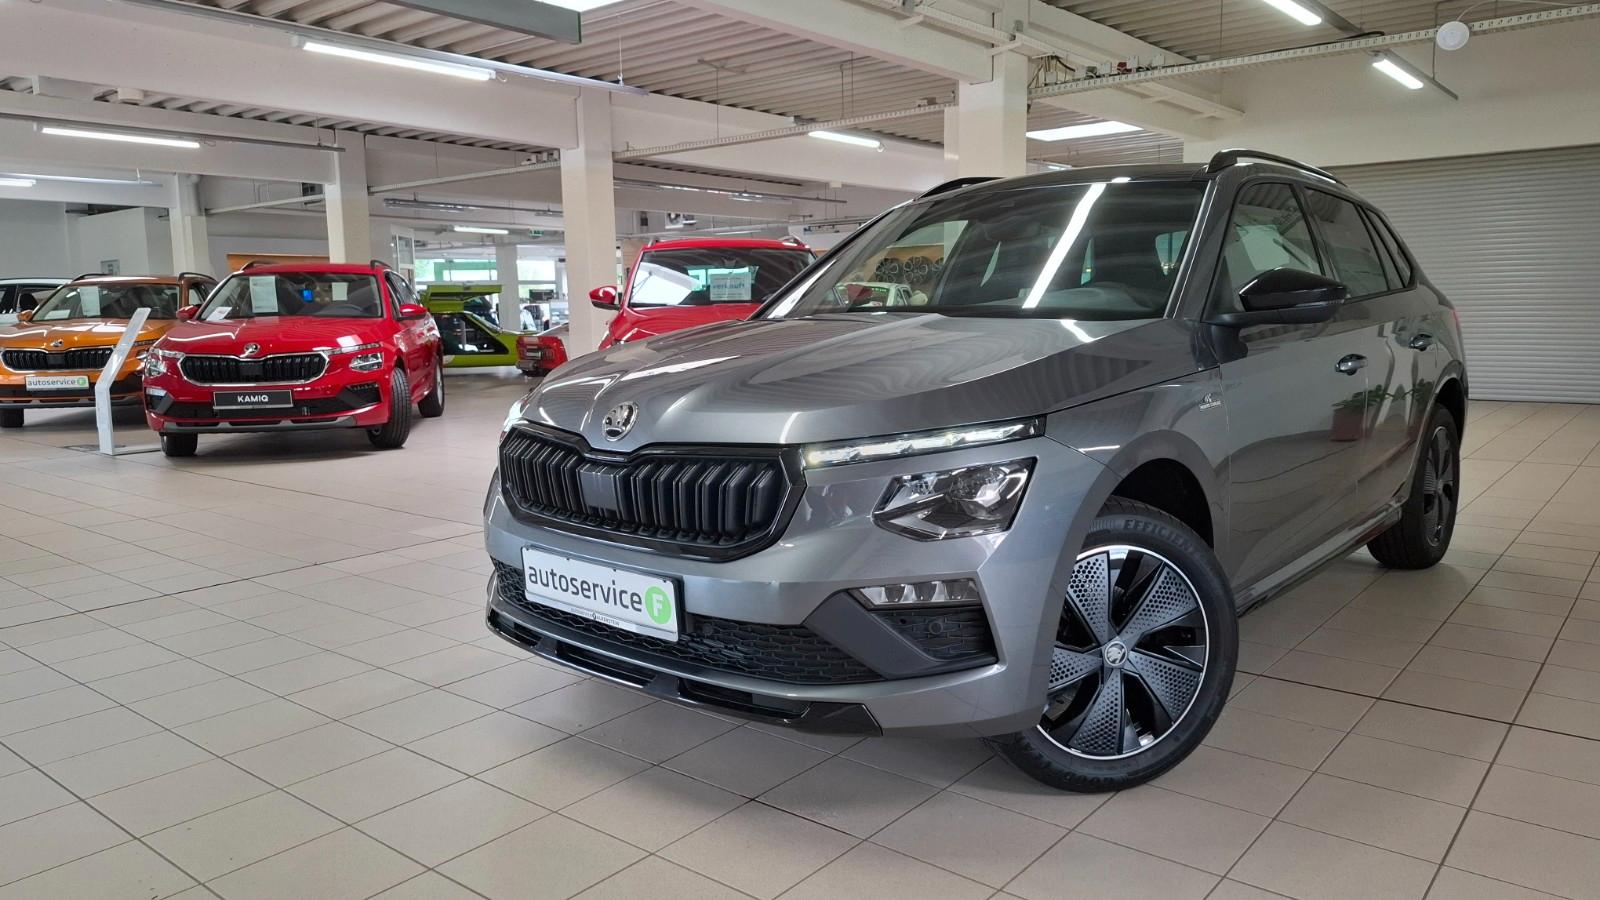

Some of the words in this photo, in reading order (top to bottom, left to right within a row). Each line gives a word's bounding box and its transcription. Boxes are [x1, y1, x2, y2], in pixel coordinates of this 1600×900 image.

[27, 377, 76, 387] autoservice
[237, 394, 269, 403] KAMIQ
[528, 565, 643, 612] autoservice
